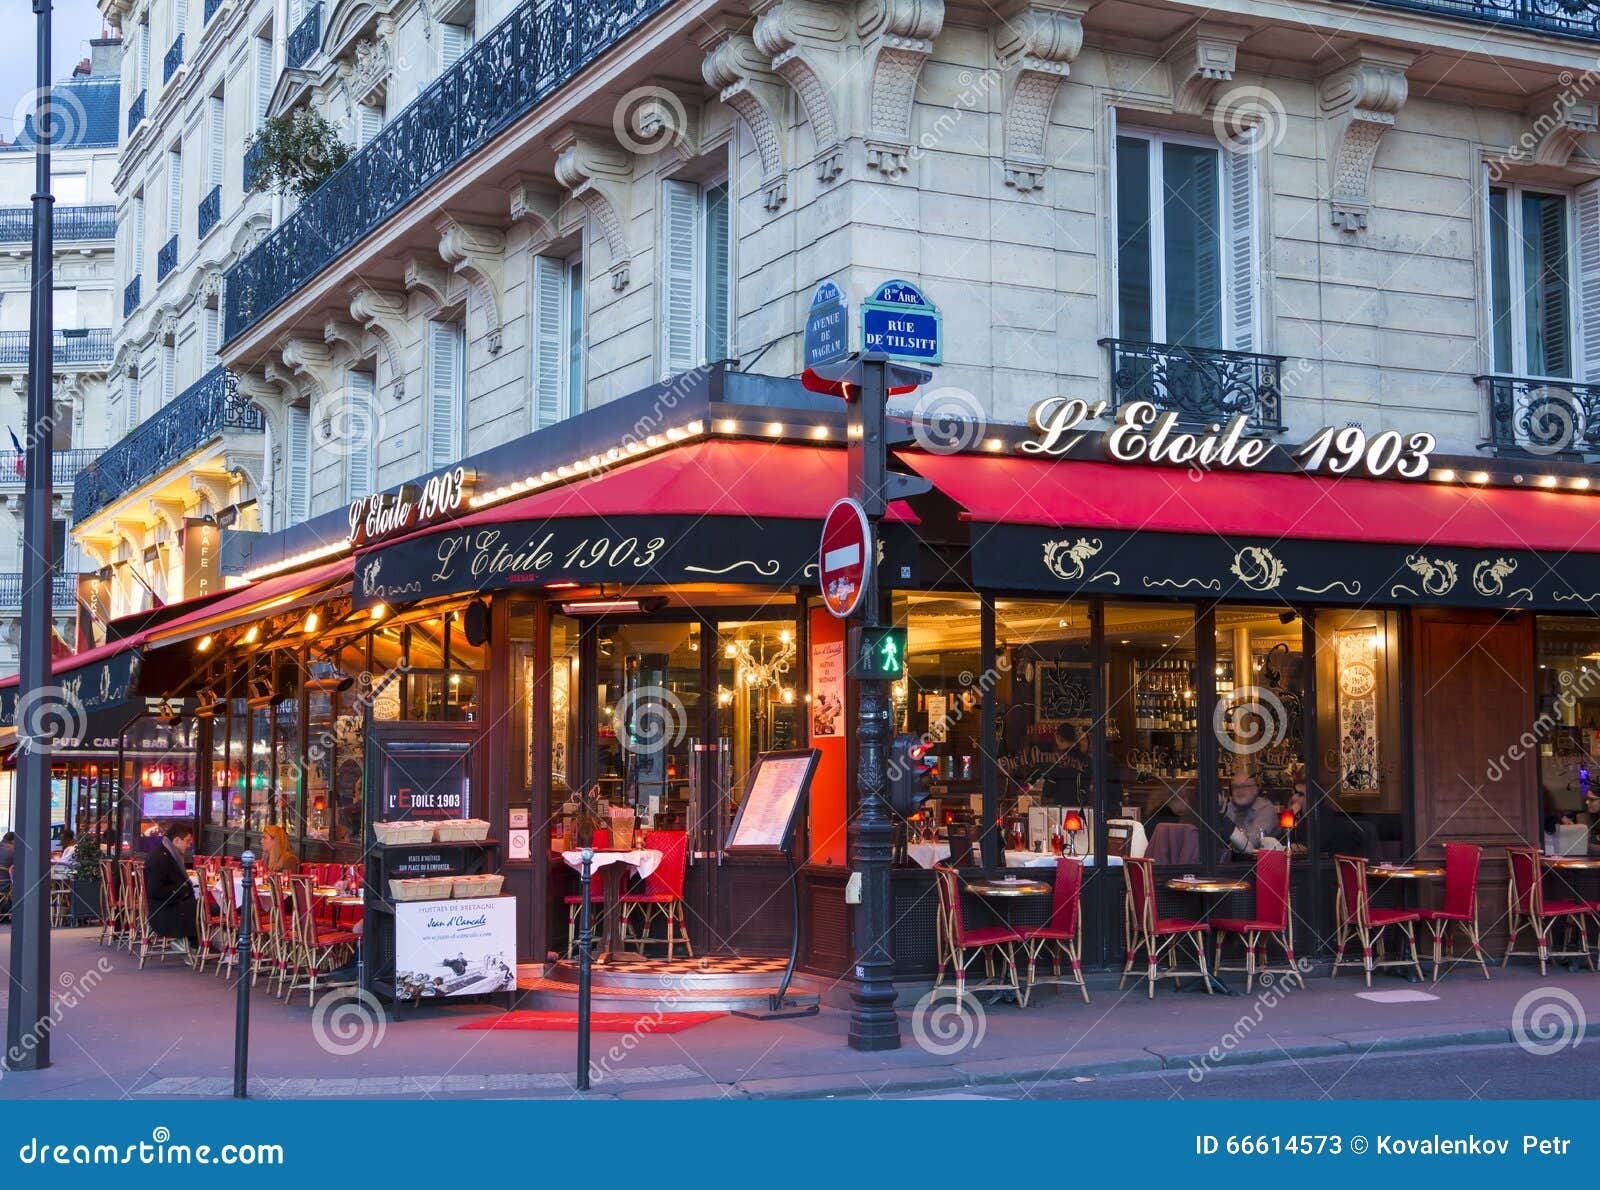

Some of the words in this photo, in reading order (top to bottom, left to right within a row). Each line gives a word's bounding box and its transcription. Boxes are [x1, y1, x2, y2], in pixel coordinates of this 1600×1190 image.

[813, 312, 840, 331] AVENUE
[888, 320, 915, 333] RUE
[821, 330, 831, 342] DE
[866, 333, 883, 345] DE
[887, 335, 936, 350] TILSITT
[812, 340, 841, 359] WAGRAM
[1021, 395, 1277, 469] L'Etoile
[1297, 425, 1436, 478] 1903
[346, 485, 411, 542] L'Etoile
[418, 466, 465, 522] 1903
[201, 525, 210, 568] CAFE
[431, 530, 554, 582] L'Etoile
[562, 537, 665, 569] 1903
[52, 737, 80, 748] PUB
[142, 739, 168, 748] BAR
[437, 794, 460, 807] 1903
[427, 917, 446, 928] Jean
[447, 914, 486, 927] d'Cancale
